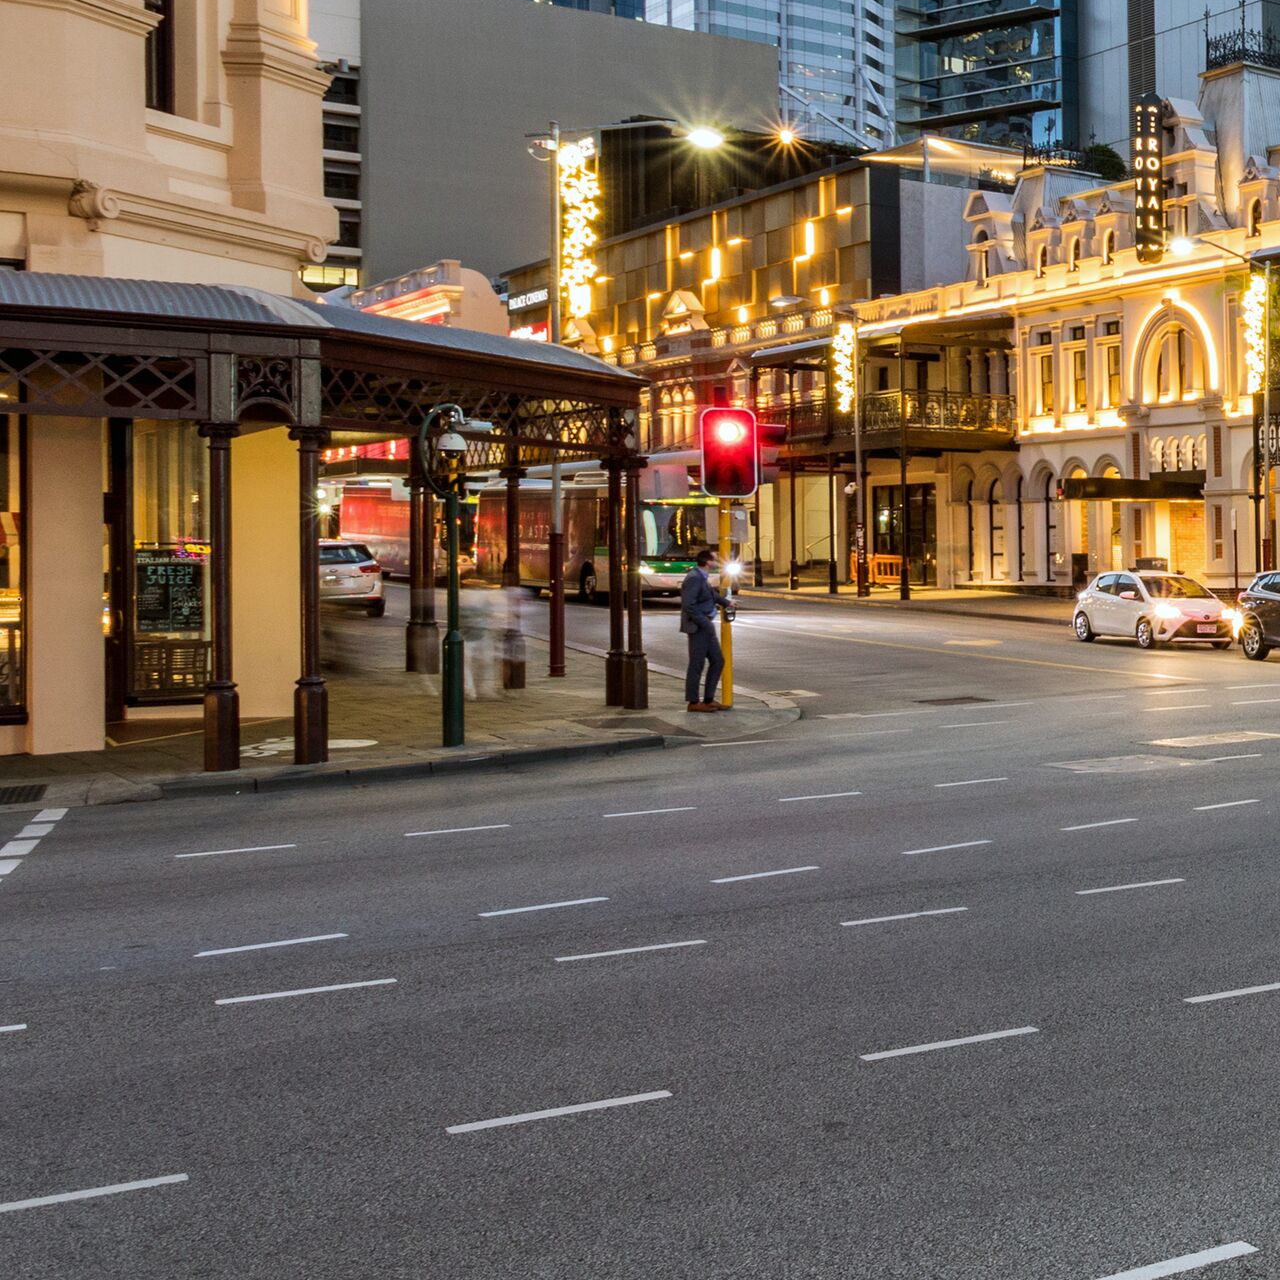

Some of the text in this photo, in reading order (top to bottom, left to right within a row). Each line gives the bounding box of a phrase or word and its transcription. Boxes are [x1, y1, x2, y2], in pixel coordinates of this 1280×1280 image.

[1135, 137, 1143, 229] ROYAL
[1146, 138, 1160, 230] ROYAL
[146, 575, 193, 585] JUICE
[147, 565, 194, 576] FRESH
